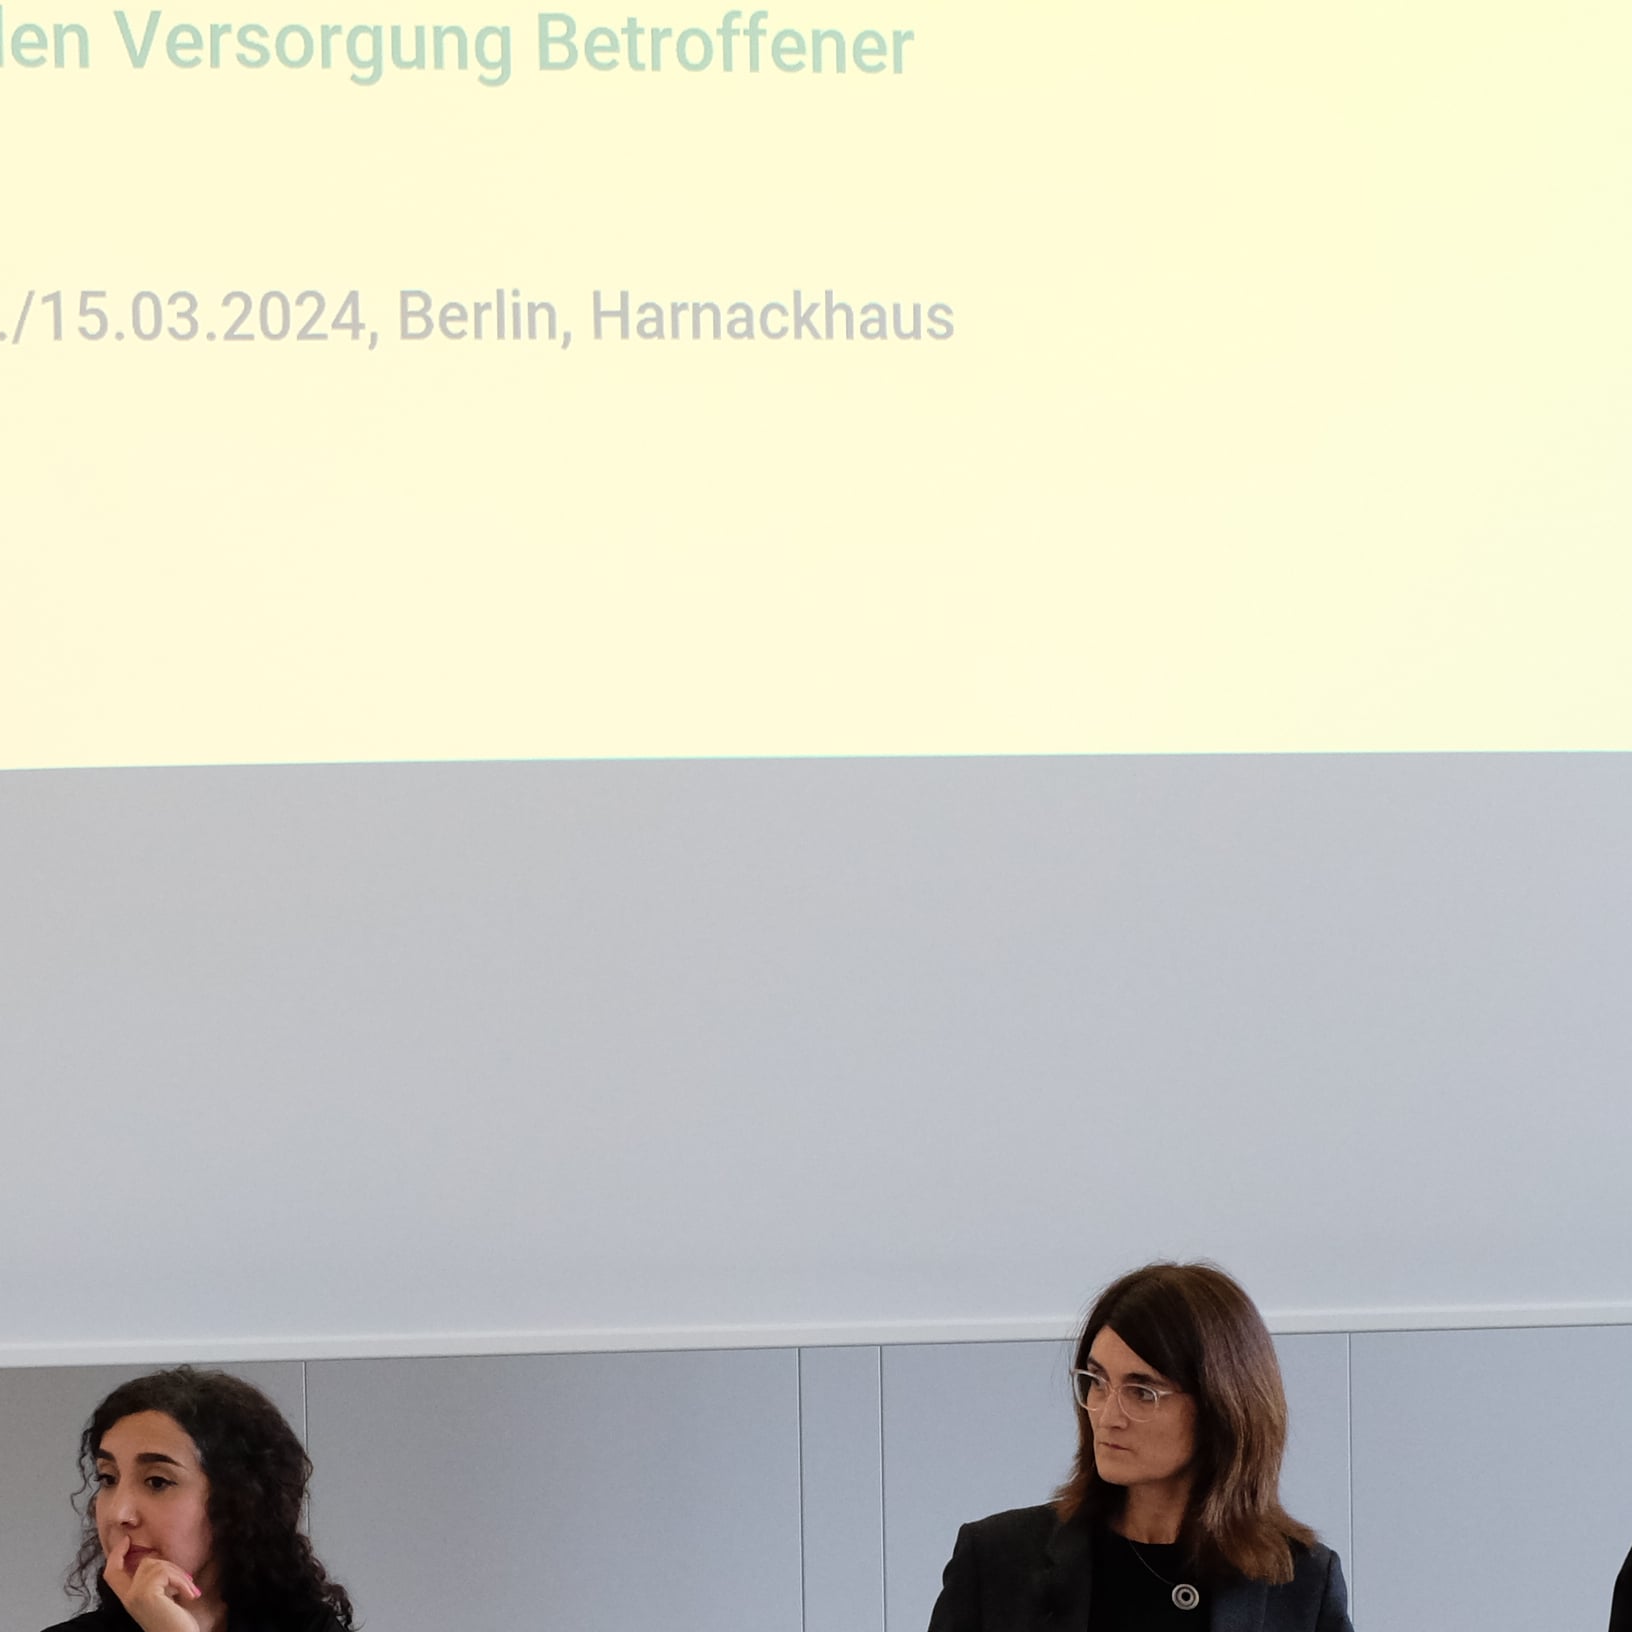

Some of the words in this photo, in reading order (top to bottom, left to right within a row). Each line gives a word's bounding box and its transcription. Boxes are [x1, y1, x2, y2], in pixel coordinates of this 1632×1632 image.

[112, 10, 513, 86] Versorgung
[536, 9, 916, 75] Betroffener
[398, 287, 573, 350] Berlin,
[592, 289, 955, 342] Harnackhaus
